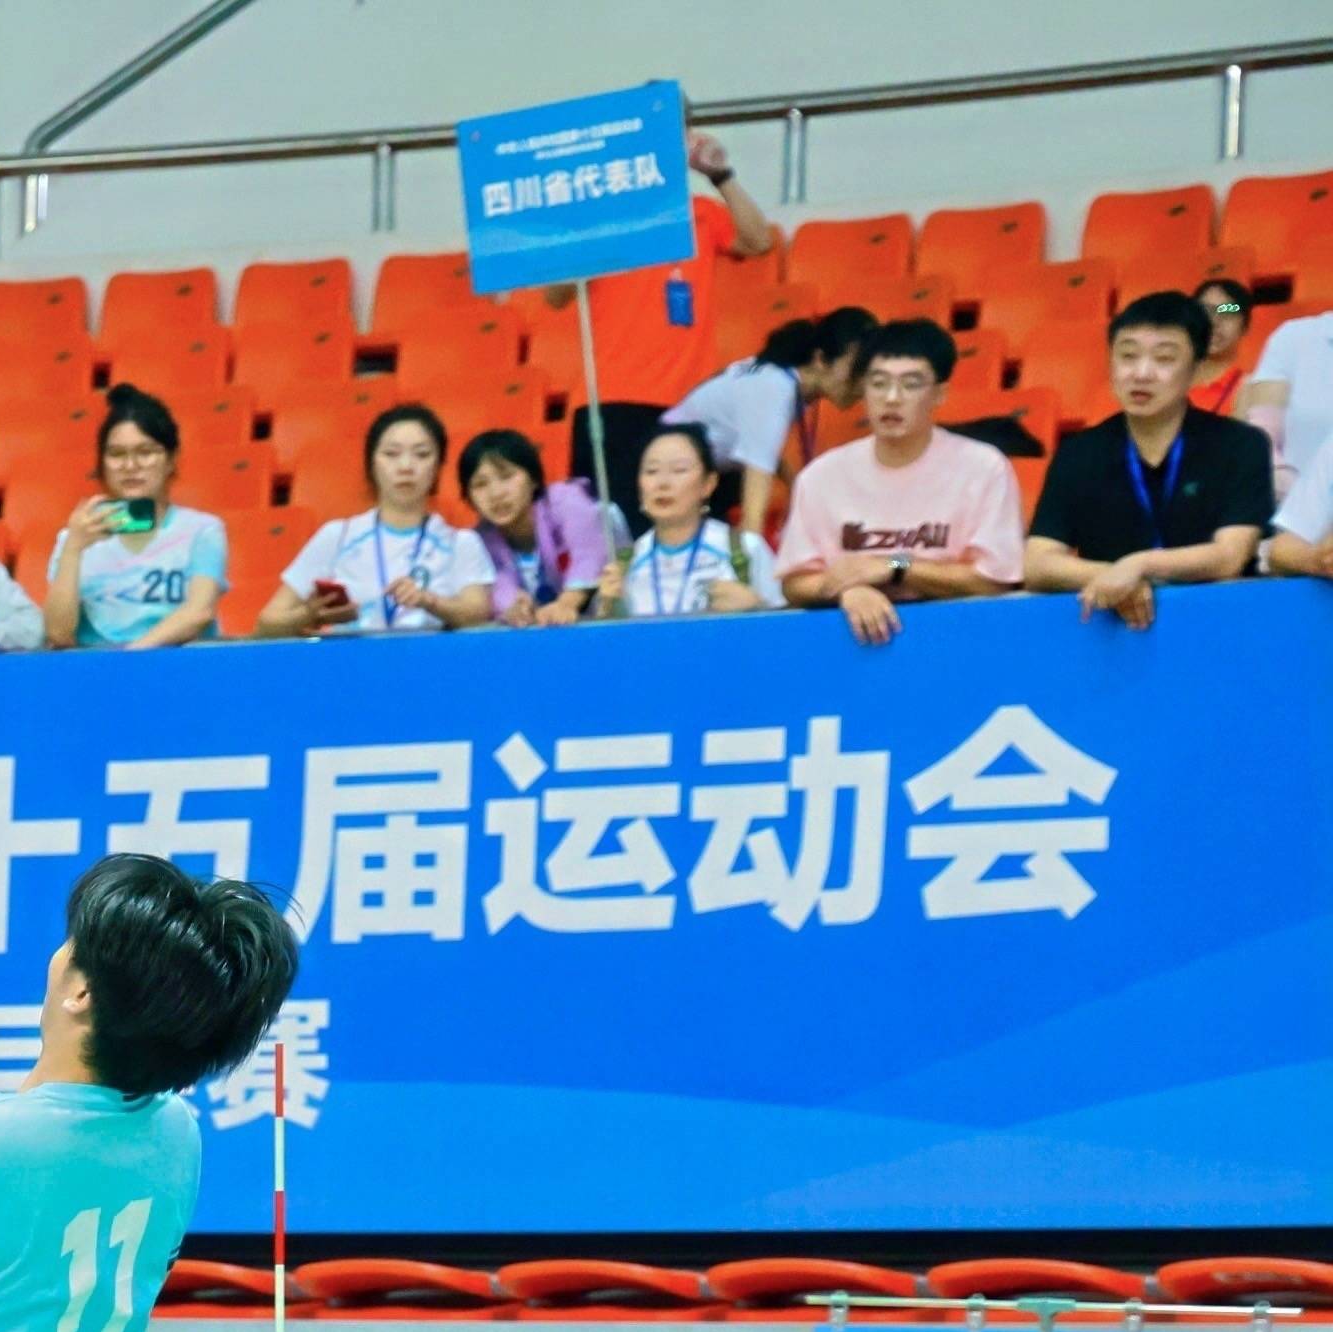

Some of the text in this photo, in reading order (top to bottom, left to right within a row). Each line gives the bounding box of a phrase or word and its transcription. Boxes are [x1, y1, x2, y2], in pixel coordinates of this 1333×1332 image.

[482, 152, 666, 218] 四川省代表队
[141, 568, 185, 605] 20
